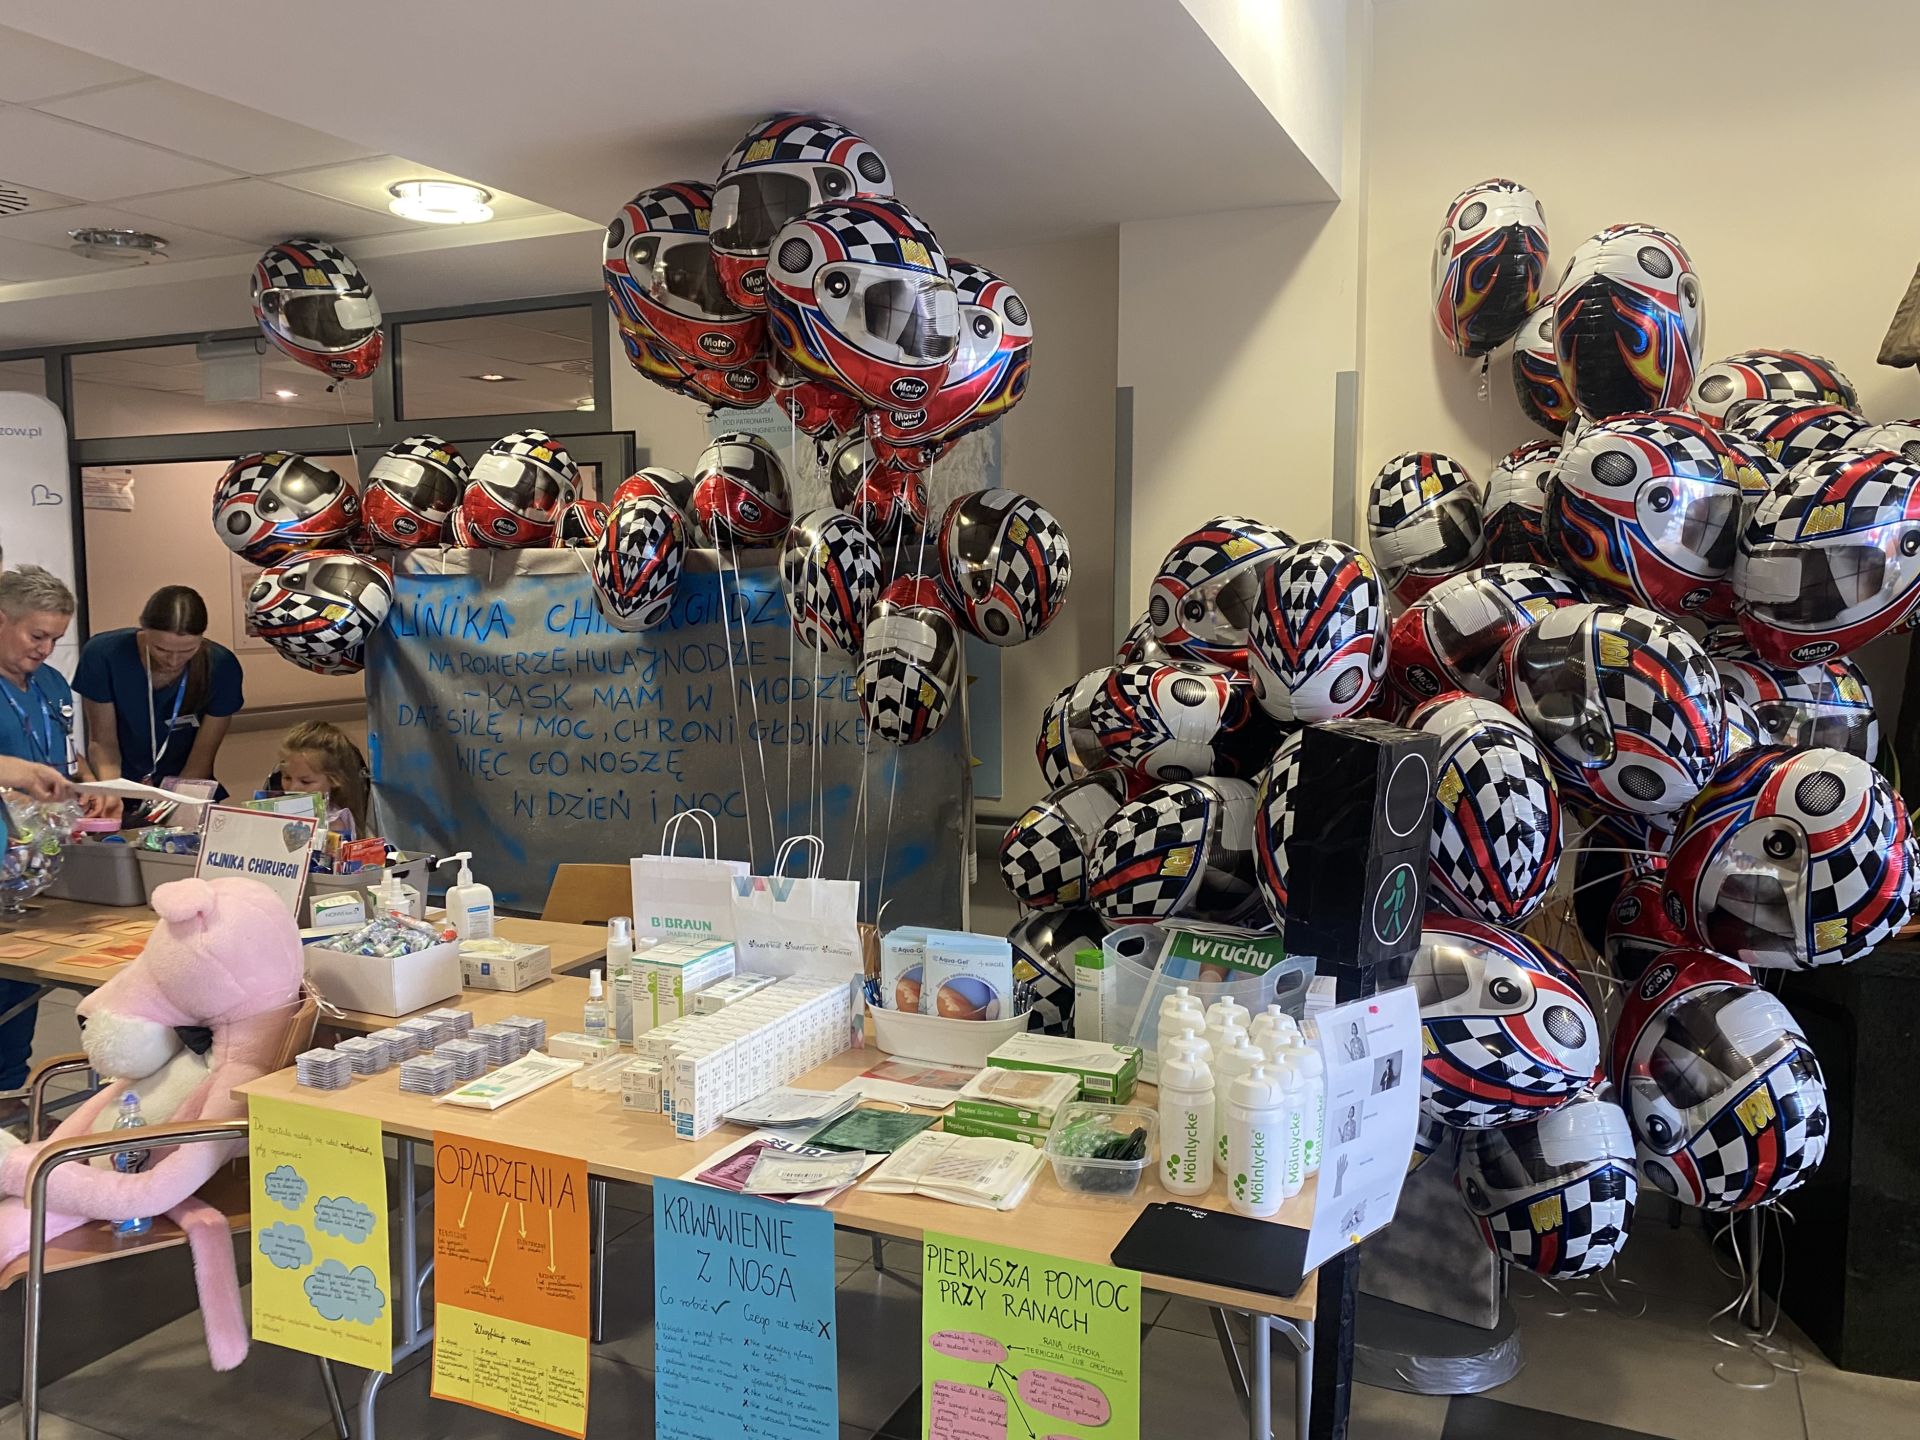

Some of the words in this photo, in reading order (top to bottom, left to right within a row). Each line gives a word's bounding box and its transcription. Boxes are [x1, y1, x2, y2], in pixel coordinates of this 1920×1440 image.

[746, 276, 765, 288] Mot
[703, 338, 732, 348] Motor
[730, 373, 756, 385] Motor
[896, 381, 926, 393] Motor
[428, 652, 455, 674] NA
[1600, 631, 1629, 667] AGA
[1797, 643, 1834, 658] Motor
[487, 682, 574, 711] KASK
[593, 683, 664, 712] MAM
[687, 684, 713, 712] W
[457, 745, 511, 782] WIĘC
[529, 750, 569, 777] GO
[580, 749, 685, 782] NOSZĘ
[673, 791, 748, 818] NOC
[206, 851, 244, 871] KLINIKA
[248, 858, 300, 880] CHIRURGII
[651, 917, 661, 927] B
[664, 917, 712, 931] BRAUN
[1209, 943, 1274, 970] ruchu
[1642, 968, 1673, 998] Motor
[1184, 1112, 1200, 1184] Mölnlycke
[1288, 1112, 1301, 1185] Mölnlycke
[436, 1143, 577, 1214] OPARZENIA
[1250, 1131, 1268, 1205] Mölnlycke
[663, 1193, 797, 1257] KRWAWIENIE
[696, 1249, 712, 1284] Z
[729, 1255, 797, 1303] NOSA
[926, 1243, 1031, 1293] PIERWSZA
[1043, 1269, 1130, 1313] POMOC
[660, 1285, 674, 1305] Co
[937, 1279, 987, 1312] PRZY
[1001, 1293, 1089, 1335] RANACH
[743, 1303, 770, 1336] Czego
[776, 1319, 790, 1330] nie
[1026, 1346, 1065, 1362] TERMICZNA
[1042, 1336, 1063, 1350] RANA
